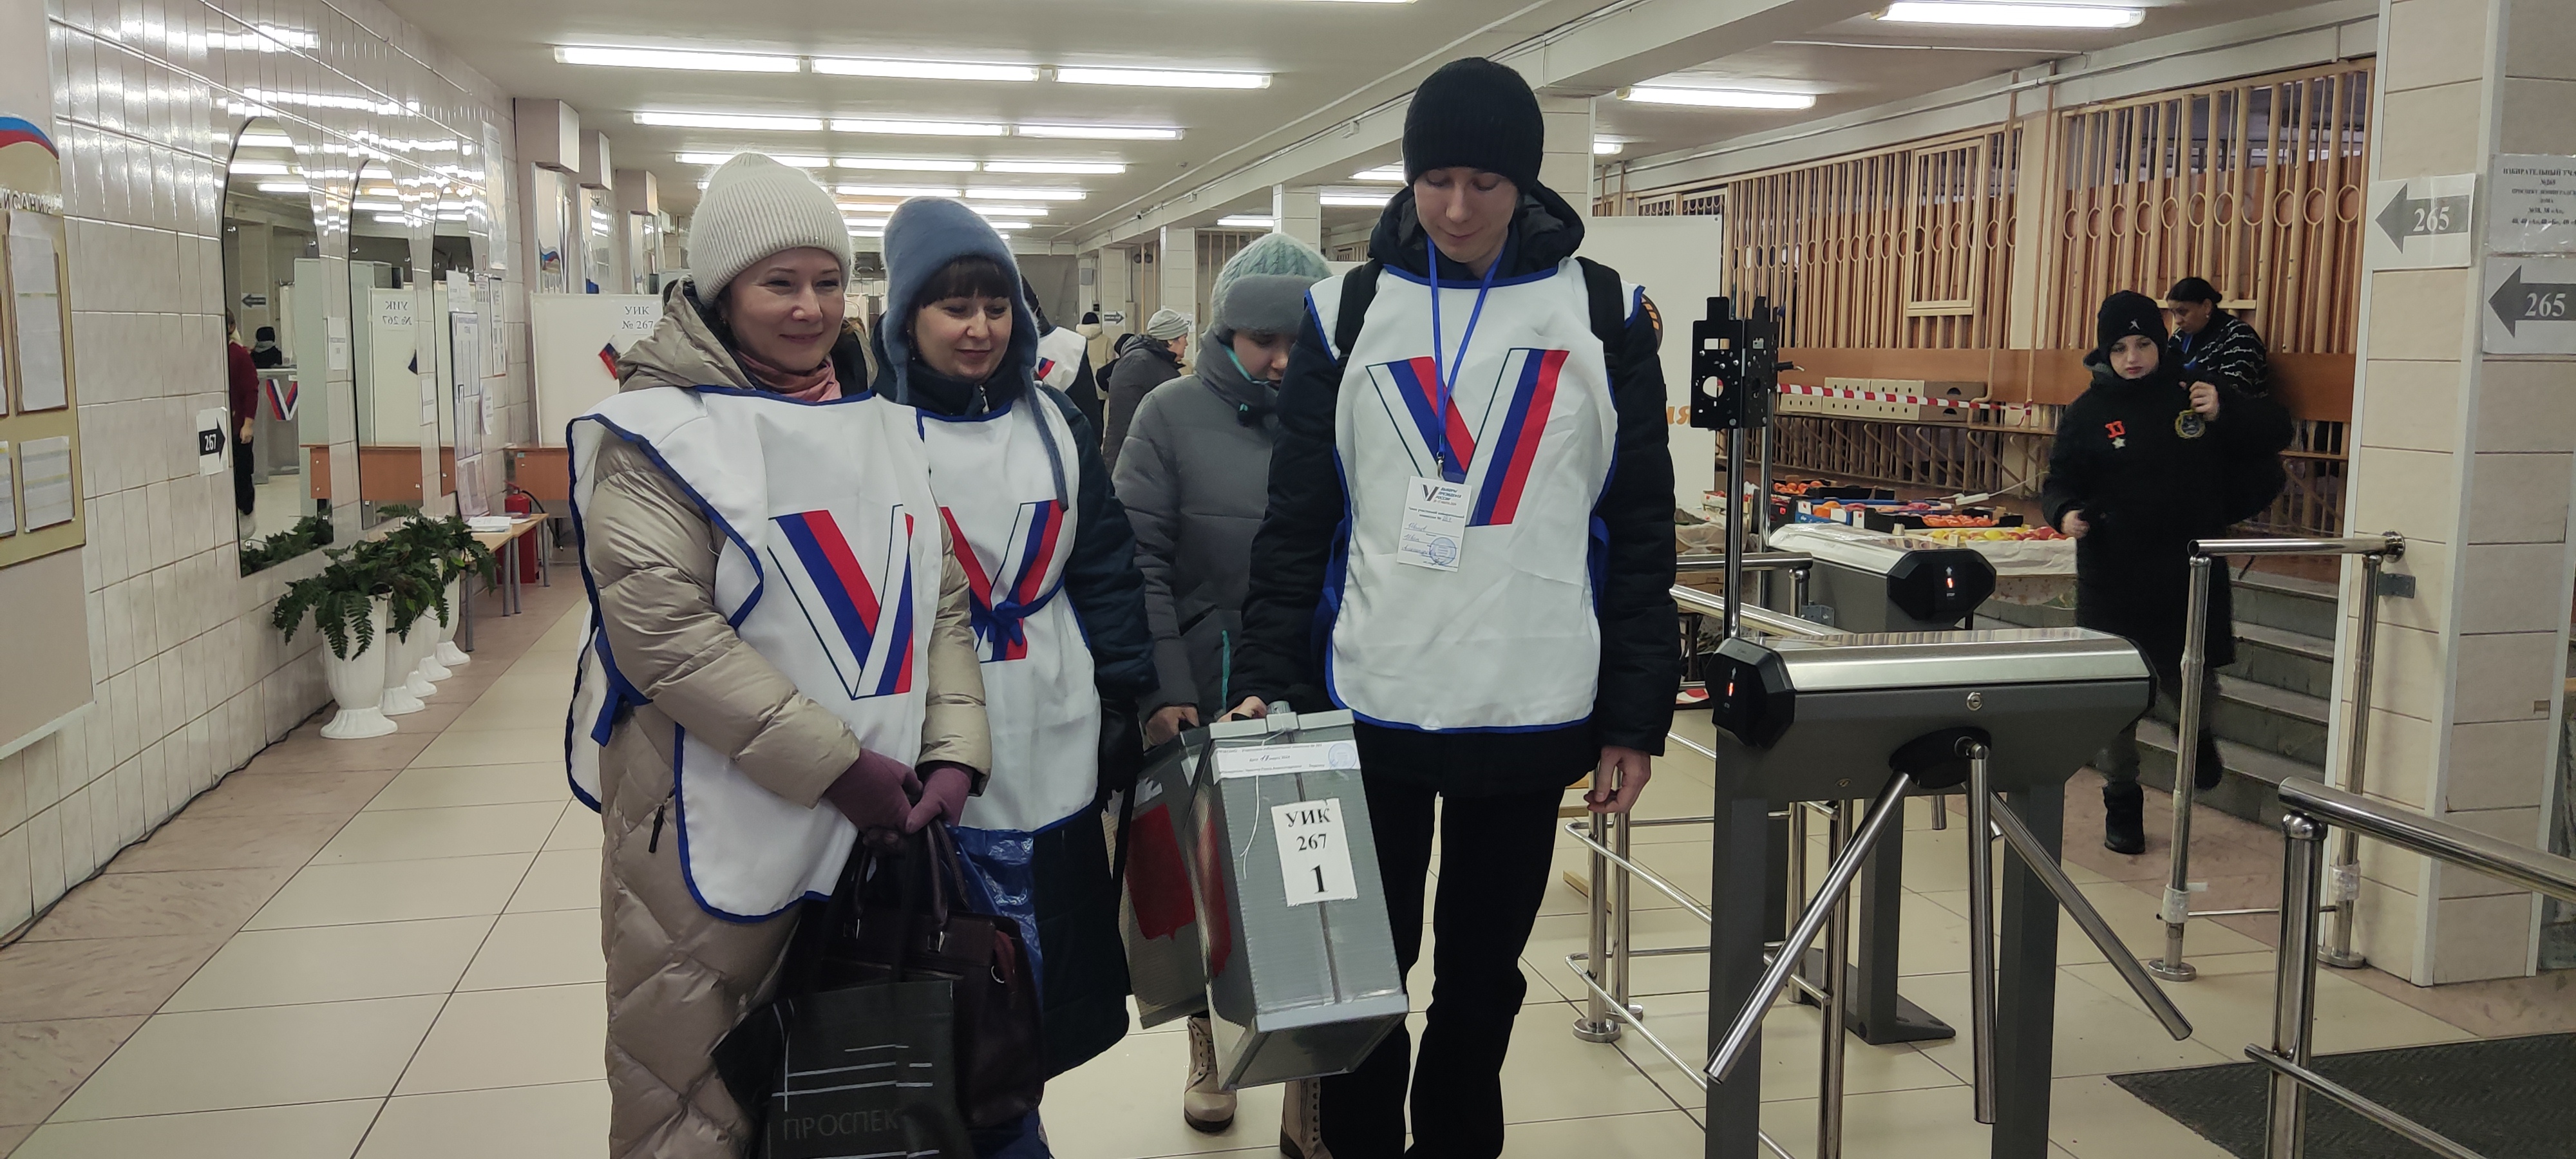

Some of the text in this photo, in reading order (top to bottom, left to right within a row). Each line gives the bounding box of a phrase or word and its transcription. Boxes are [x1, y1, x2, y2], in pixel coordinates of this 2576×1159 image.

[2412, 206, 2450, 232] 265
[624, 306, 649, 315] УИК
[2524, 292, 2566, 317] 265
[621, 321, 653, 330] № 267
[204, 433, 217, 451] 267
[1285, 807, 1331, 827] УИК
[1296, 833, 1327, 852] 267
[1309, 864, 1329, 894] 1
